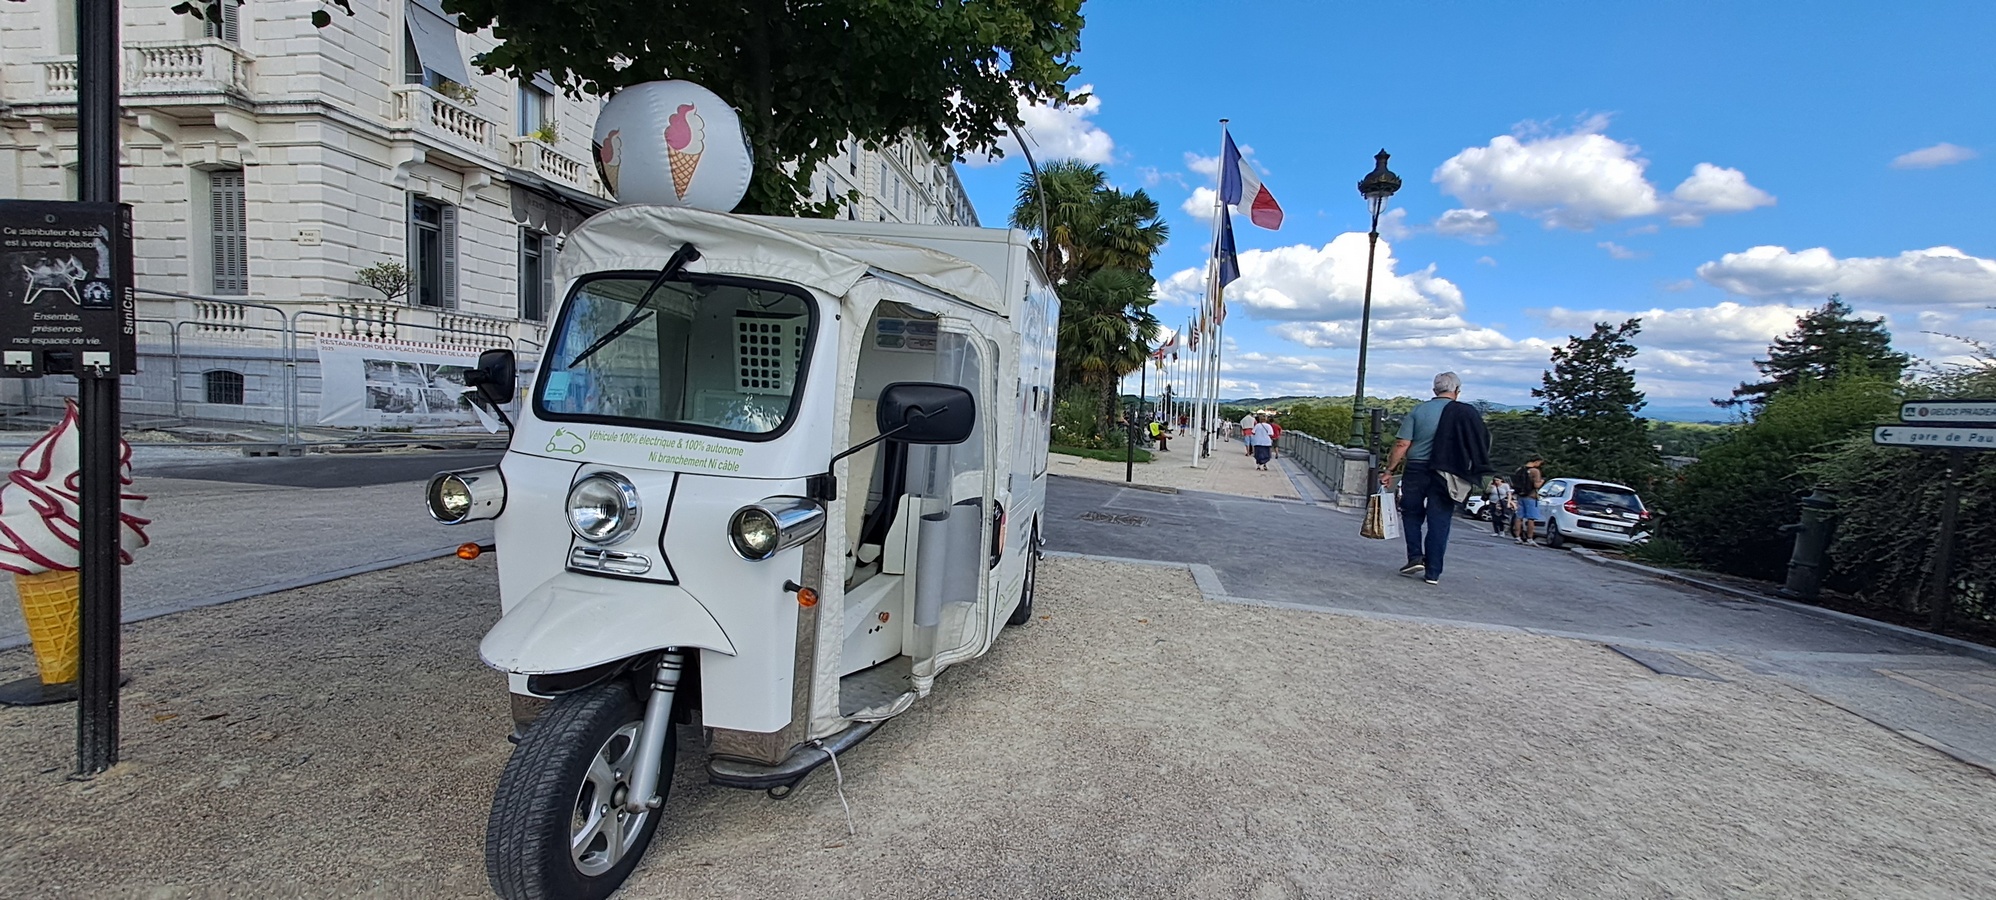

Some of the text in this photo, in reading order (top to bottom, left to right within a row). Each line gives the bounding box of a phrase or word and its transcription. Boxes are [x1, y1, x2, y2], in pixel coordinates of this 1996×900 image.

[19, 227, 67, 236] distributeur
[69, 228, 80, 236] de
[21, 238, 28, 247] à
[33, 312, 81, 321] Ensemble,
[31, 324, 83, 334] préservons
[31, 338, 71, 346] espaces
[86, 337, 102, 345] vie.
[320, 339, 373, 349] RESTAURATION
[589, 429, 744, 456] Véhicule 100% électrique & 100% autonome
[1910, 432, 1994, 443] gare de Pau
[648, 451, 740, 472] Ni branchement Ni câble
